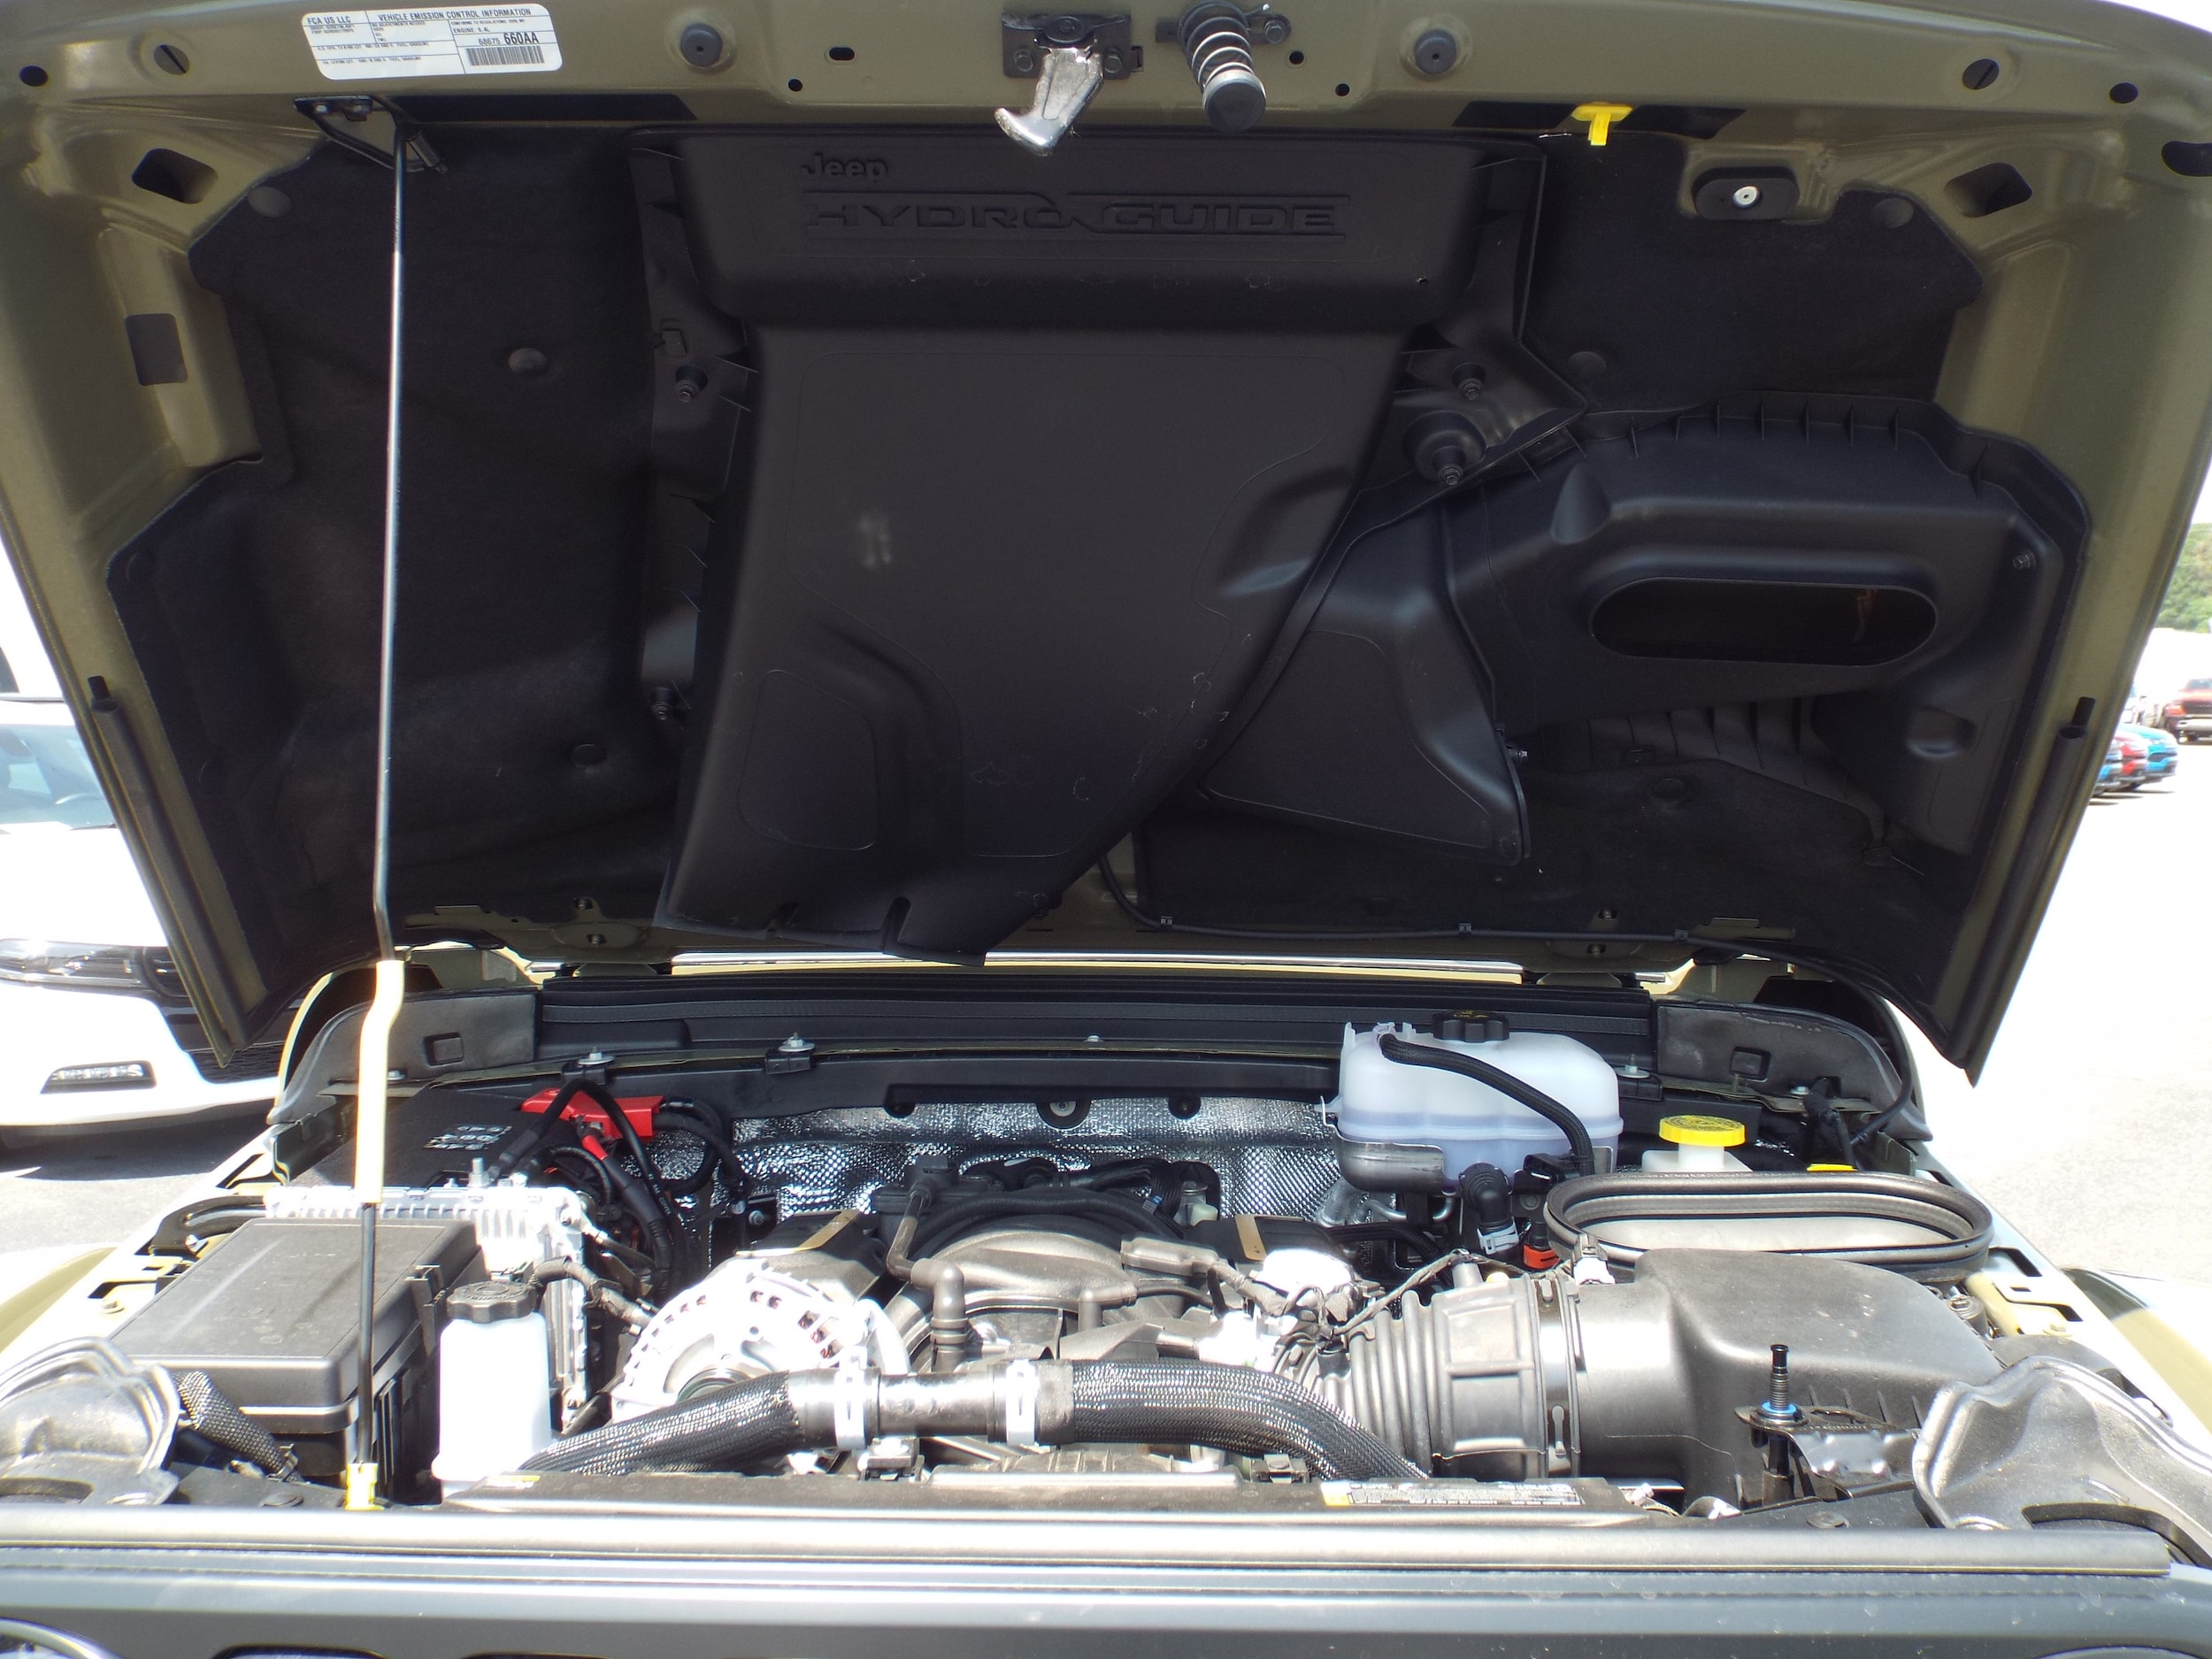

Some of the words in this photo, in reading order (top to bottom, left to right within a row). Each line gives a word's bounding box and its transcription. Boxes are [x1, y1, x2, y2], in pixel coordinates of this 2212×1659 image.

[410, 12, 444, 20] EMISSION
[503, 32, 539, 44] 660AA
[801, 151, 887, 183] Jeep
[1102, 203, 1335, 233] GUIDE
